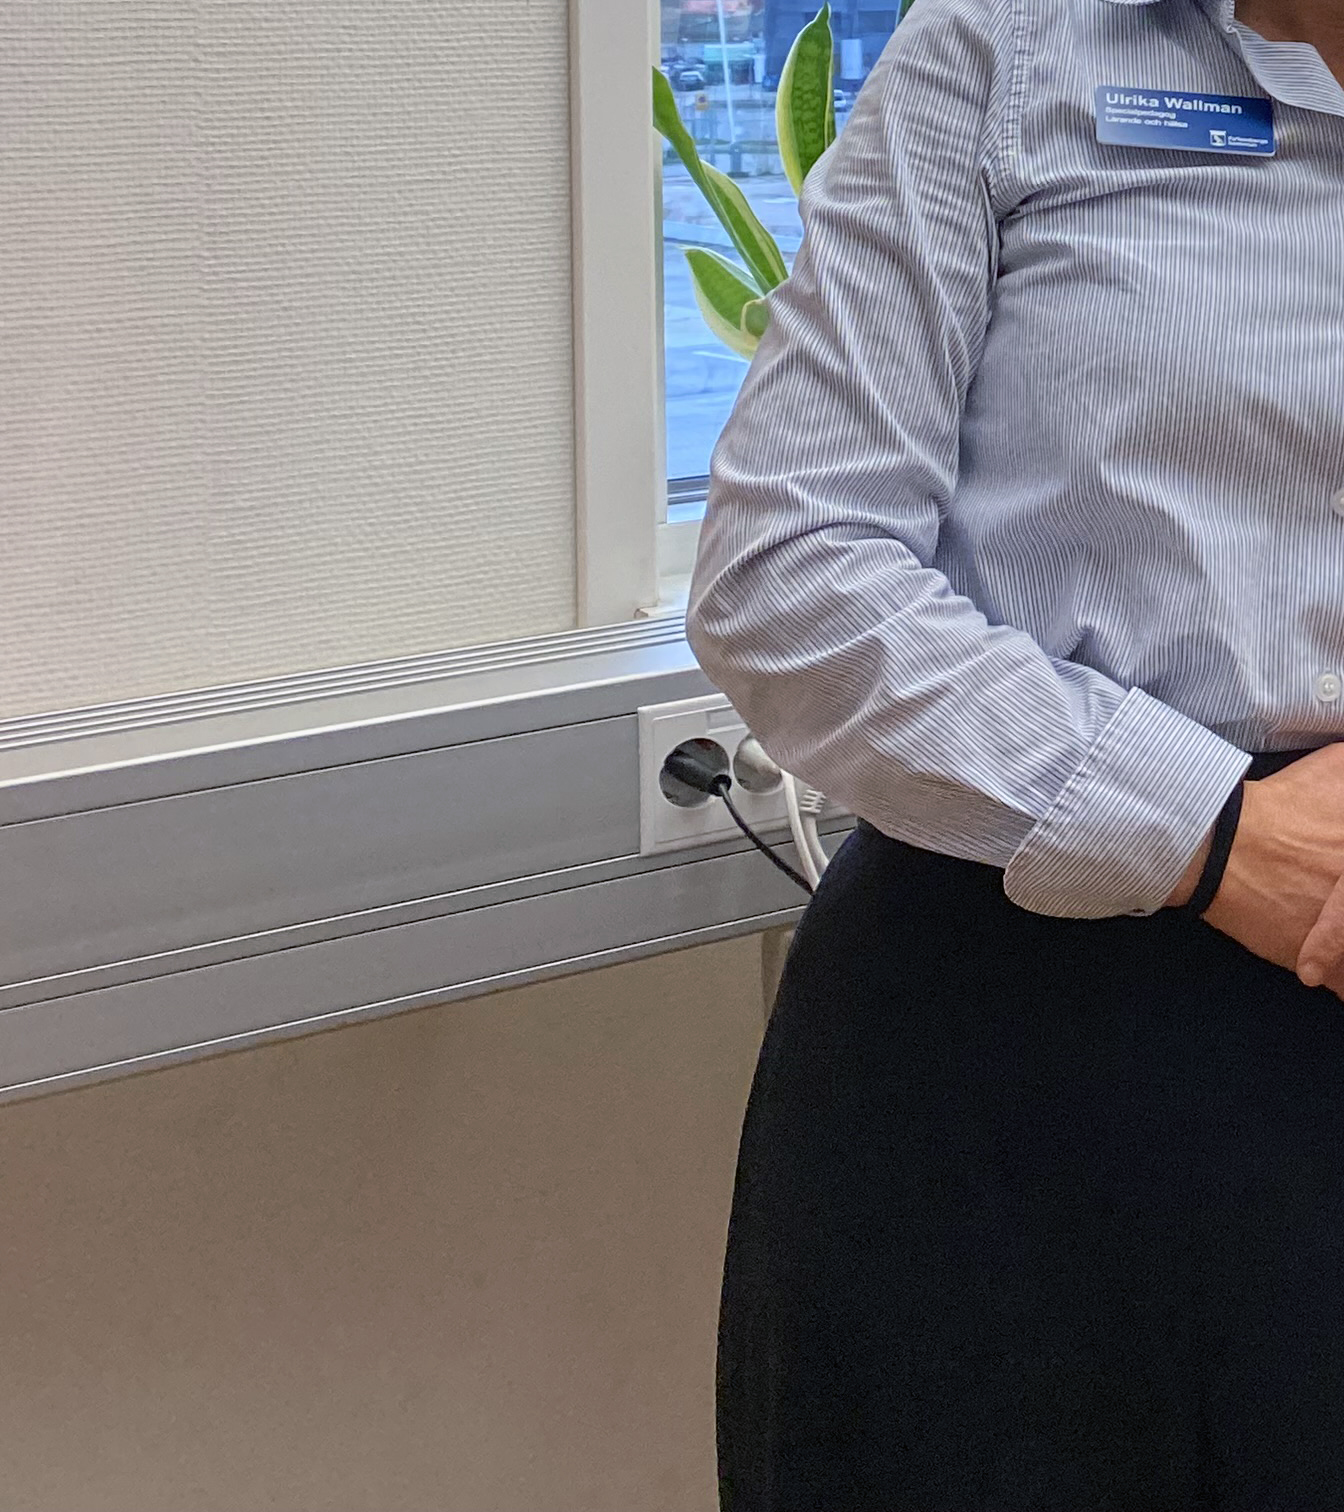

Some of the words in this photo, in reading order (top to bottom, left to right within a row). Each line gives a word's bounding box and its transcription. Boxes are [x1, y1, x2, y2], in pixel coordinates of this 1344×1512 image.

[1105, 92, 1160, 108] Ulrika
[1164, 96, 1243, 115] Wallman
[1105, 105, 1177, 120] Specialpedagog
[1143, 119, 1162, 127] och
